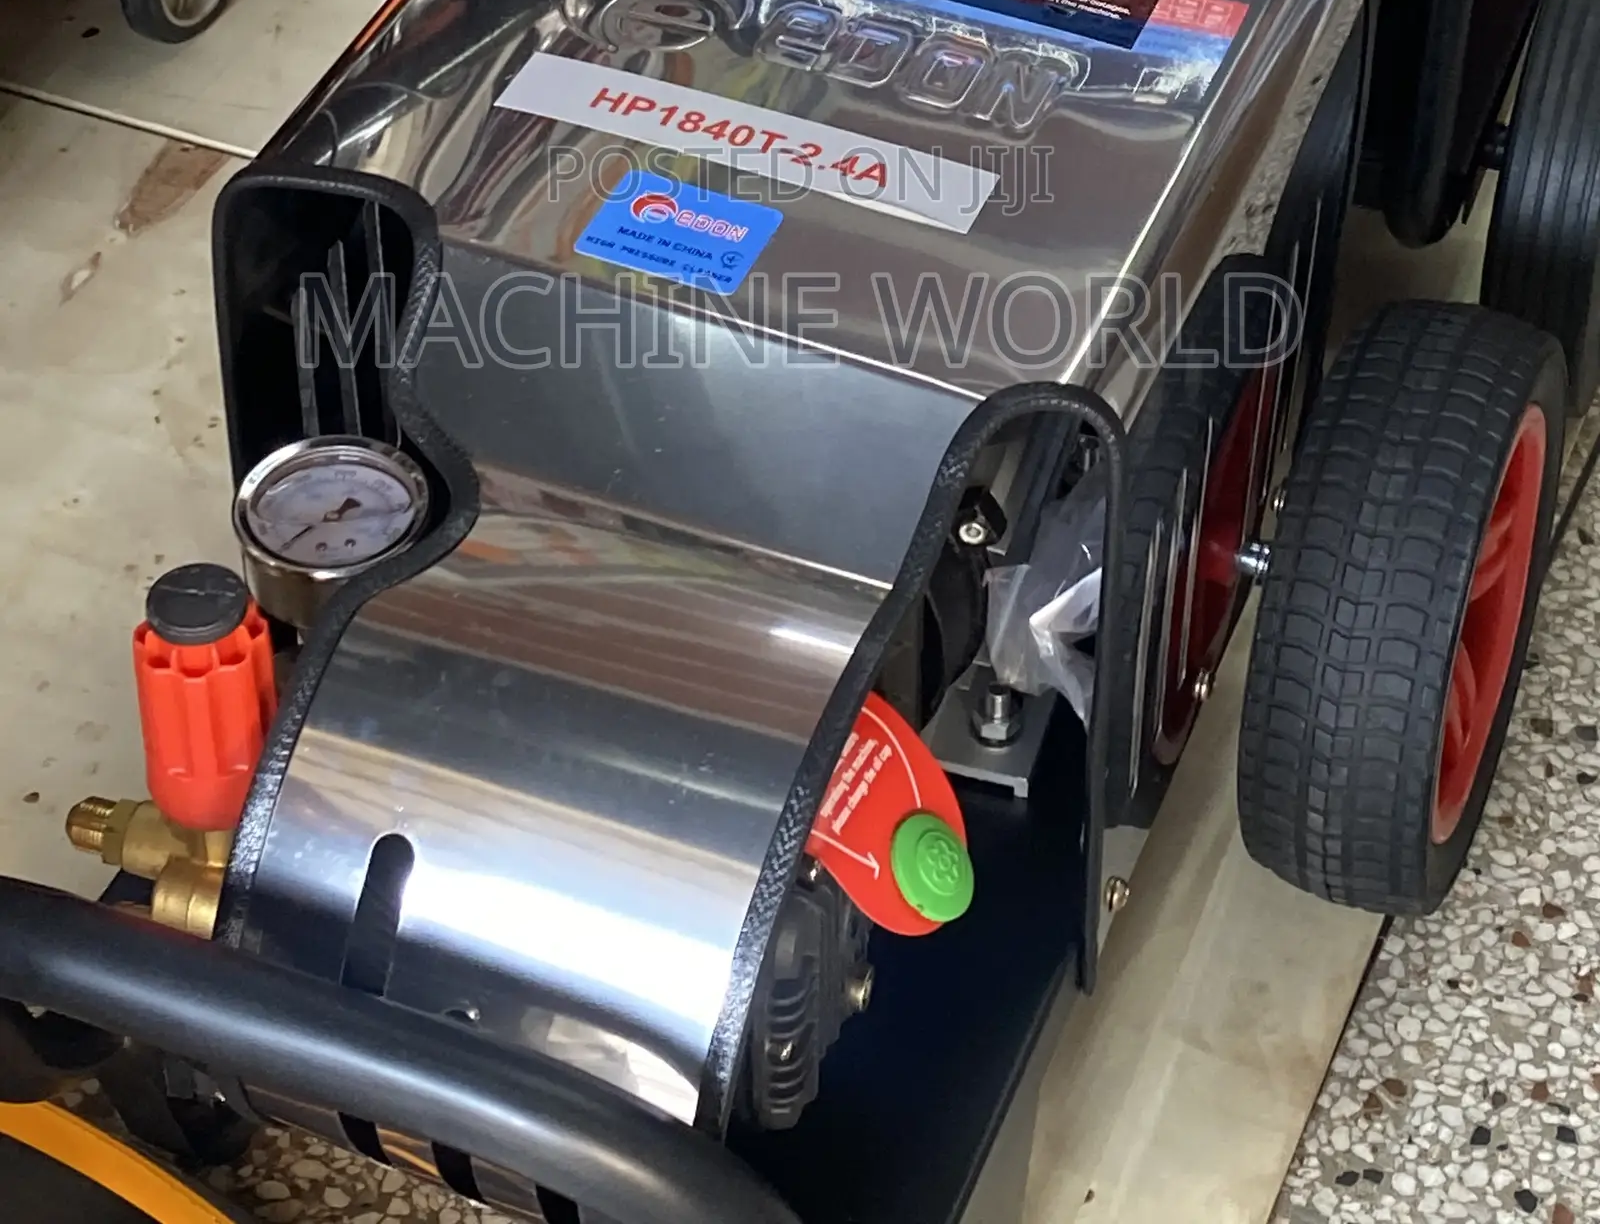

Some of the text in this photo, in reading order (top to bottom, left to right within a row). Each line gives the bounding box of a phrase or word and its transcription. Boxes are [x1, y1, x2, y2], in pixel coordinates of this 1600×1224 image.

[590, 87, 887, 189] HP1840T-2.4A
[617, 226, 713, 262] MADE IN CHINA
